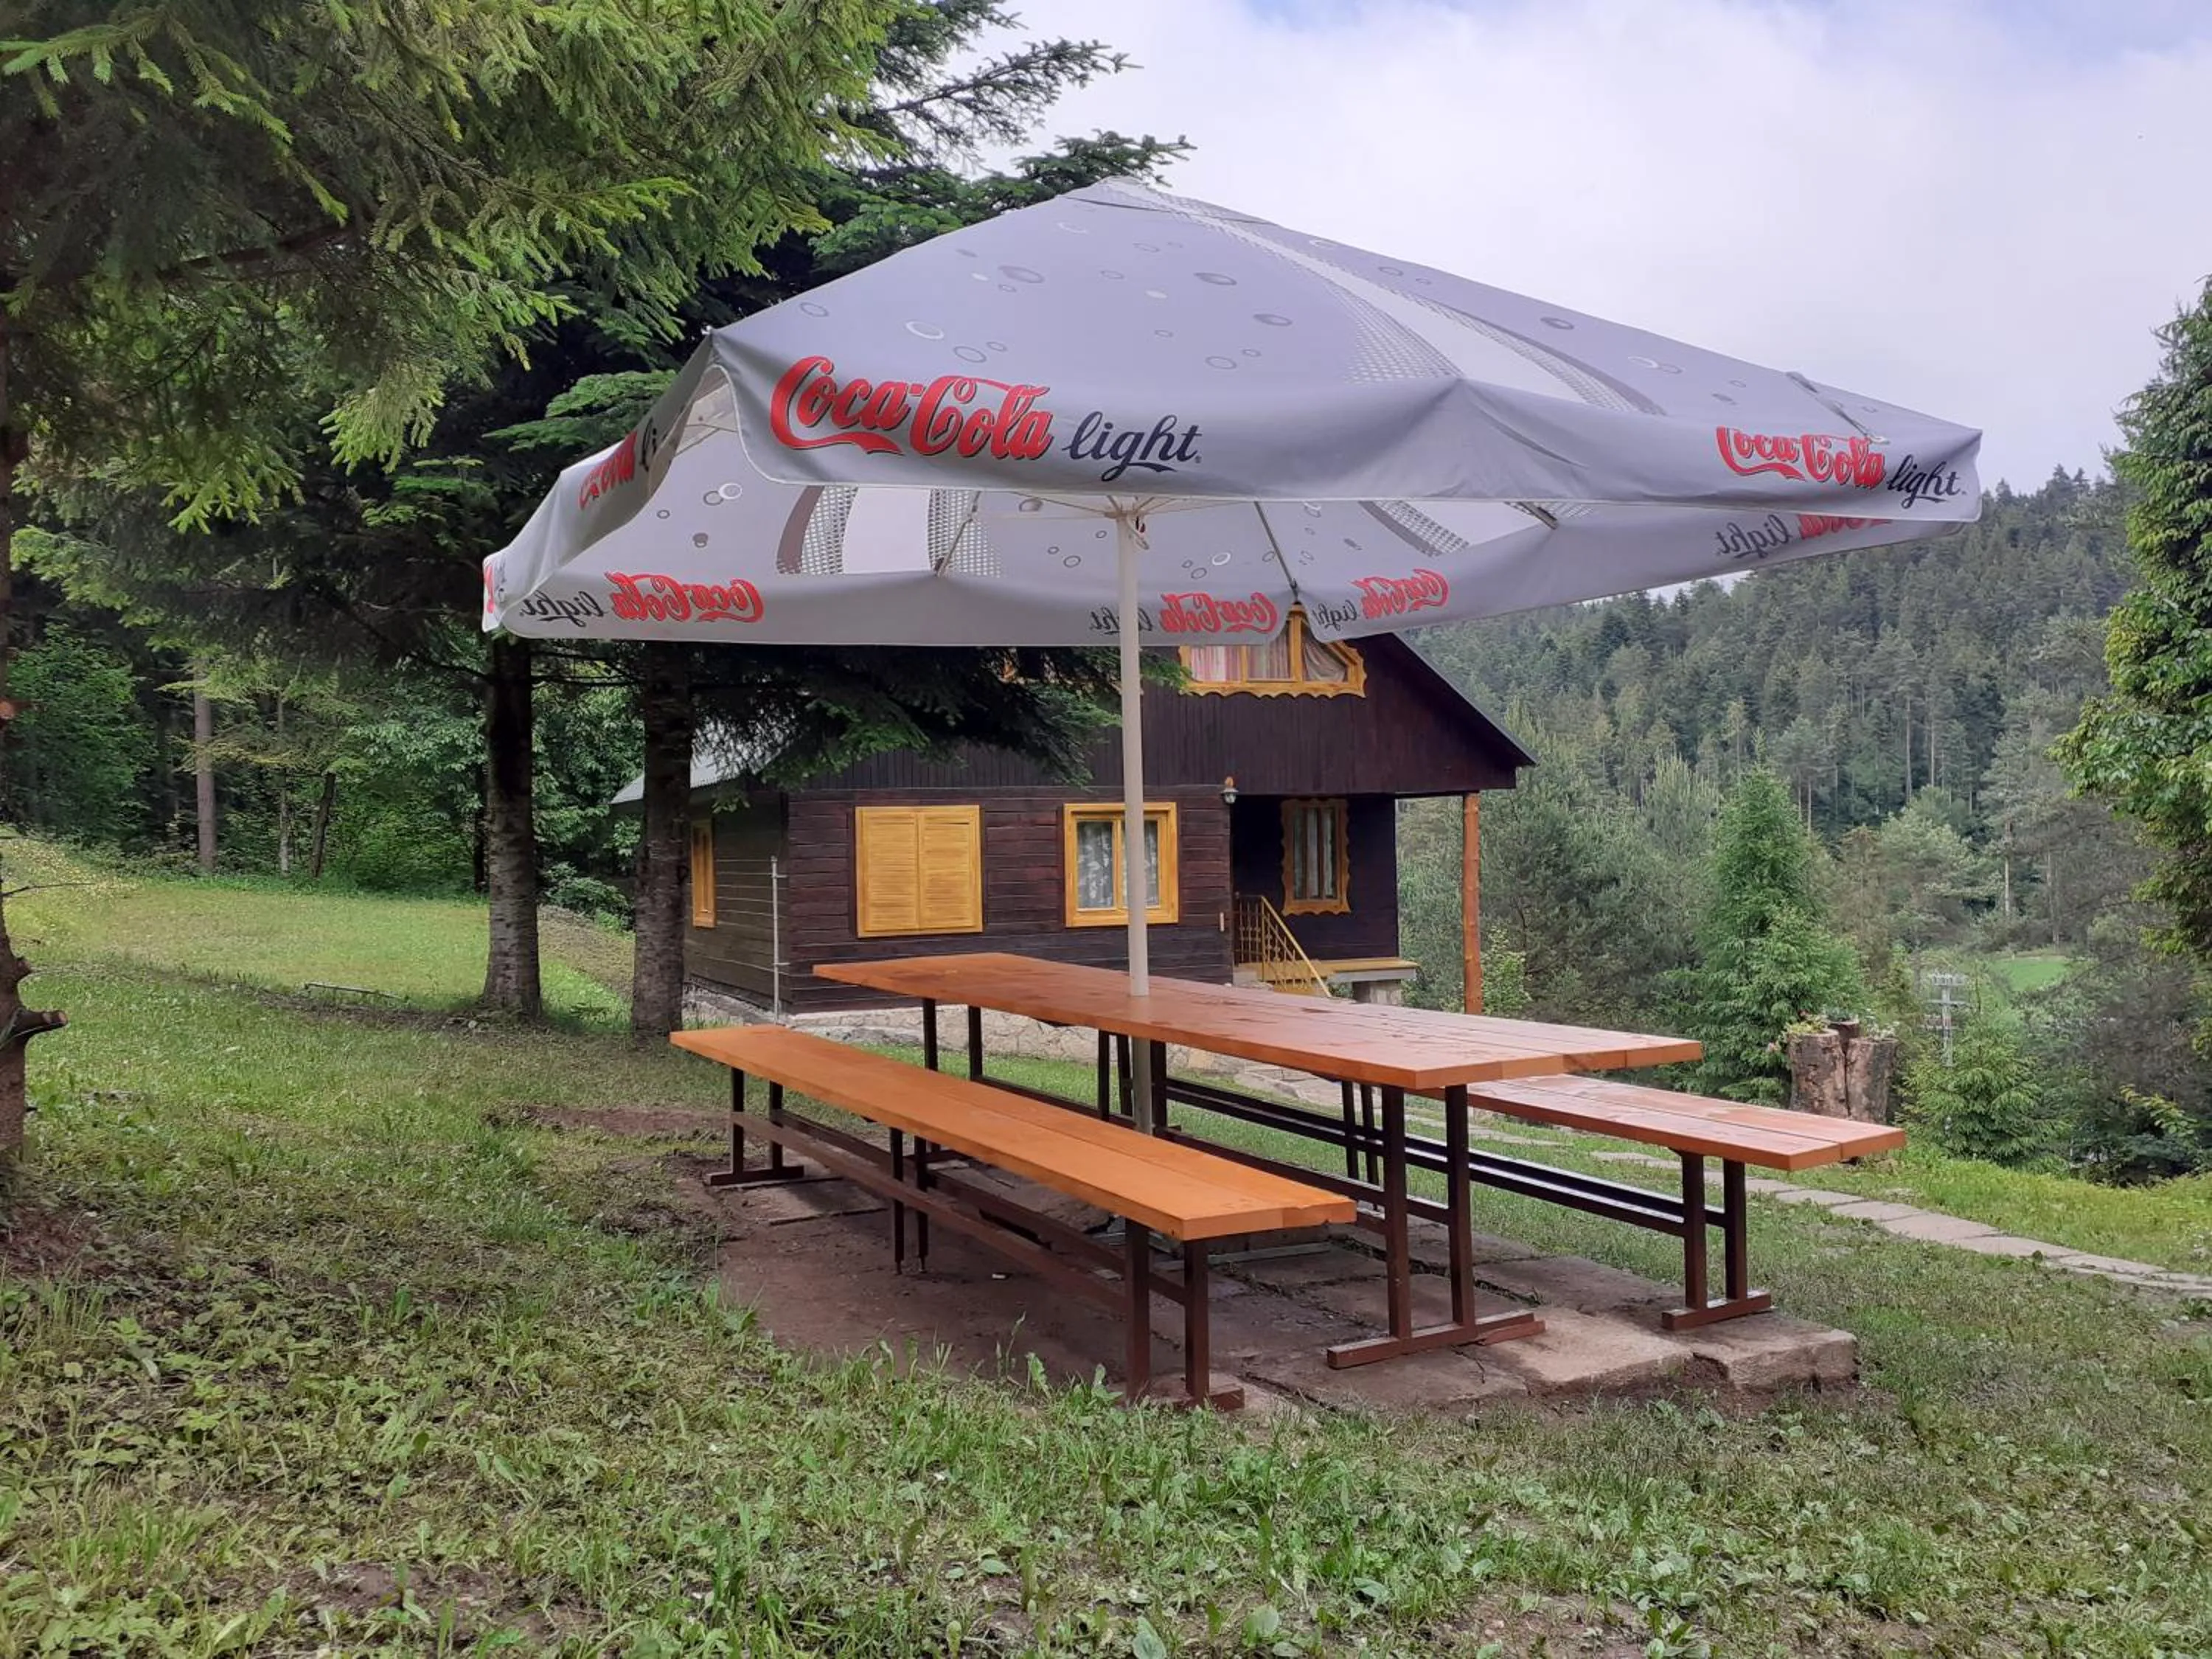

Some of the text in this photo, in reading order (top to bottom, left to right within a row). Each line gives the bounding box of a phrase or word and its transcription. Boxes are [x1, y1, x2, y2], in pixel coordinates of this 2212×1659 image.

[770, 355, 1200, 481] Coca-Cola light
[1717, 425, 1961, 509] Coca-Cola light
